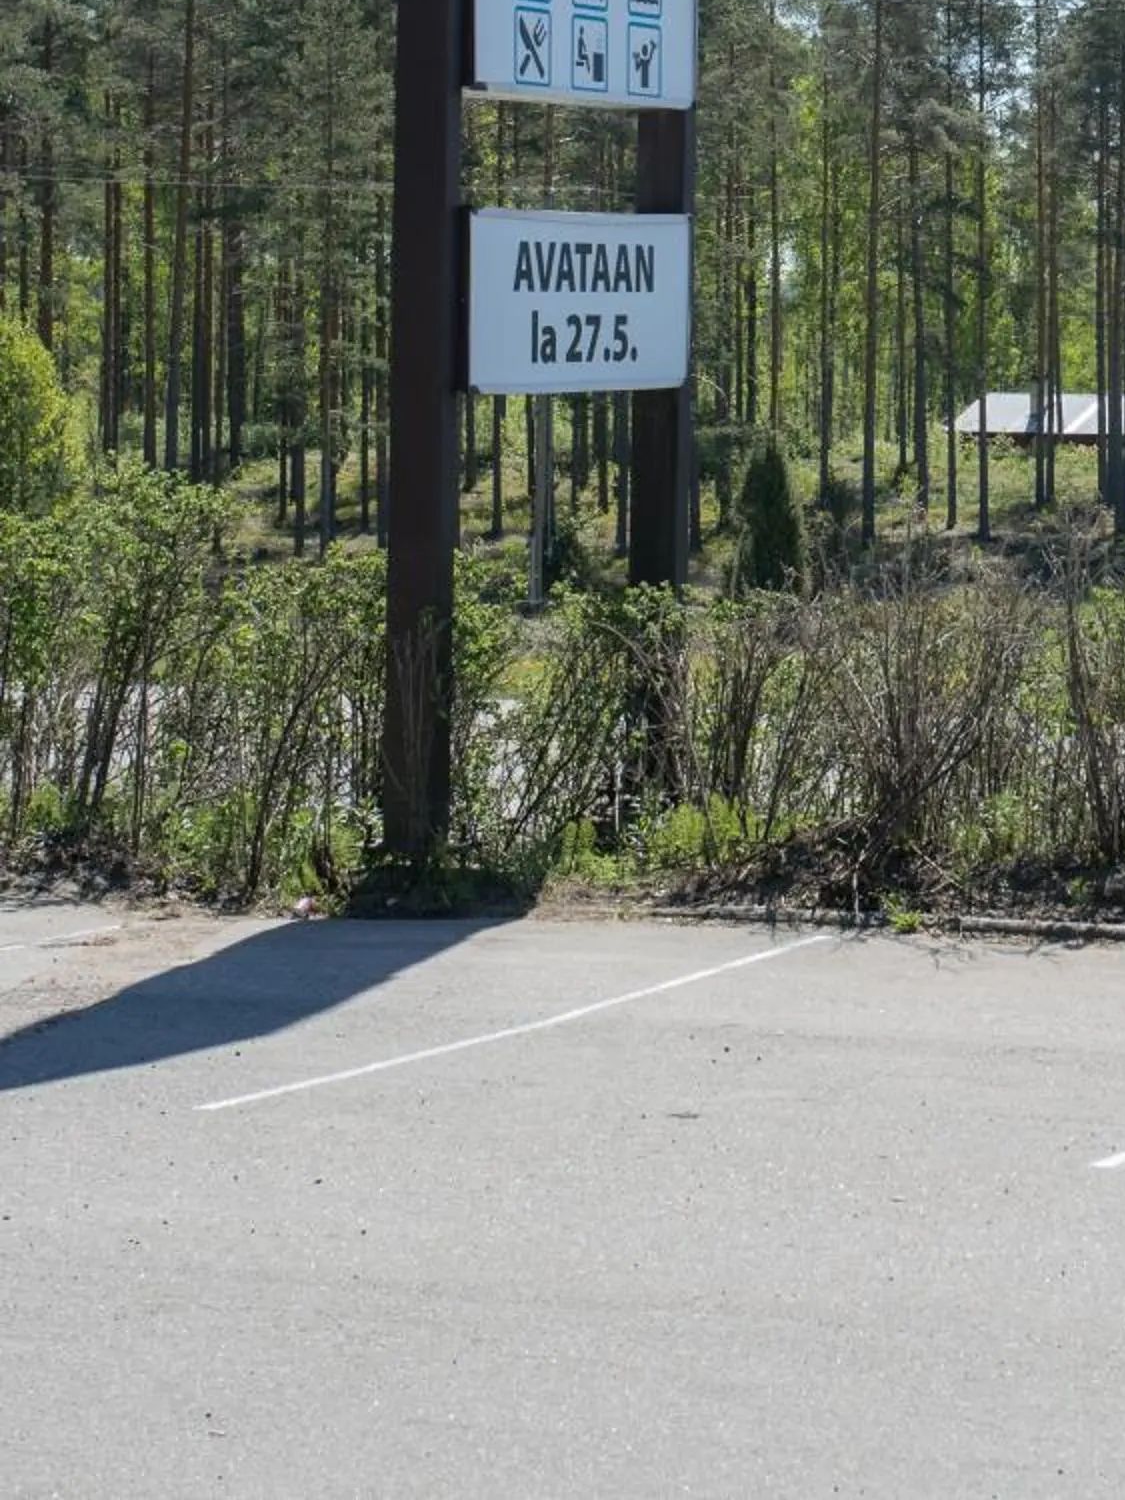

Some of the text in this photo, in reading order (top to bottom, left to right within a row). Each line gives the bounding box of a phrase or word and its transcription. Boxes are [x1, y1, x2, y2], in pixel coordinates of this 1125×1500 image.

[513, 241, 654, 293] AVATAAN
[531, 310, 638, 364] la 27.5.
